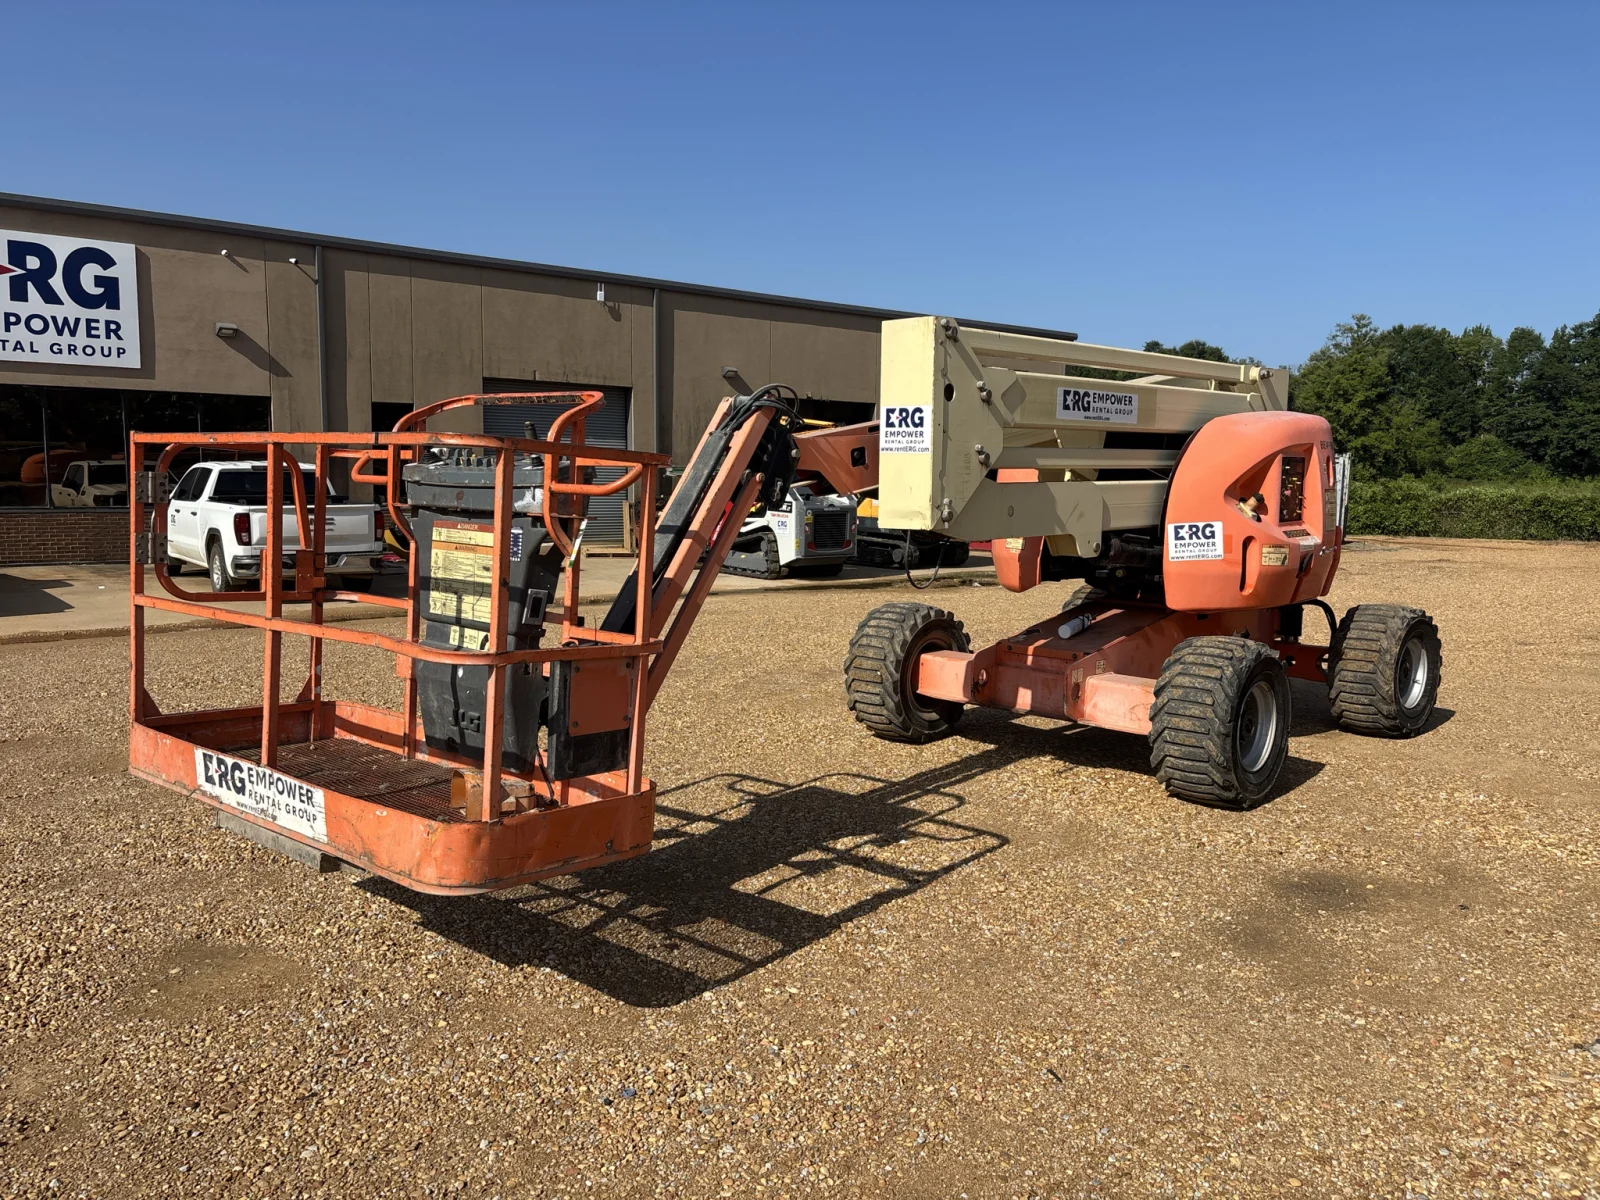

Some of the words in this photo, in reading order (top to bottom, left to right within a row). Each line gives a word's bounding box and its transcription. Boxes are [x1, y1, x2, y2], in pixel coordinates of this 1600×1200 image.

[3, 311, 124, 341] POWER
[49, 342, 127, 358] GROUP
[1062, 389, 1091, 413] ERG
[1092, 392, 1133, 407] EMPOWER
[885, 406, 924, 429] ERG
[1092, 406, 1113, 414] RENTAL
[1114, 408, 1133, 416] GROUP
[884, 430, 924, 438] EMPOWER
[461, 523, 479, 531] DANGER
[1173, 522, 1216, 541] ERG
[1174, 541, 1217, 549] EMPOWER
[202, 752, 247, 797] ERG
[247, 766, 316, 808] EMPOWER
[248, 789, 282, 811] RENTAL
[284, 803, 317, 824] GROUP
